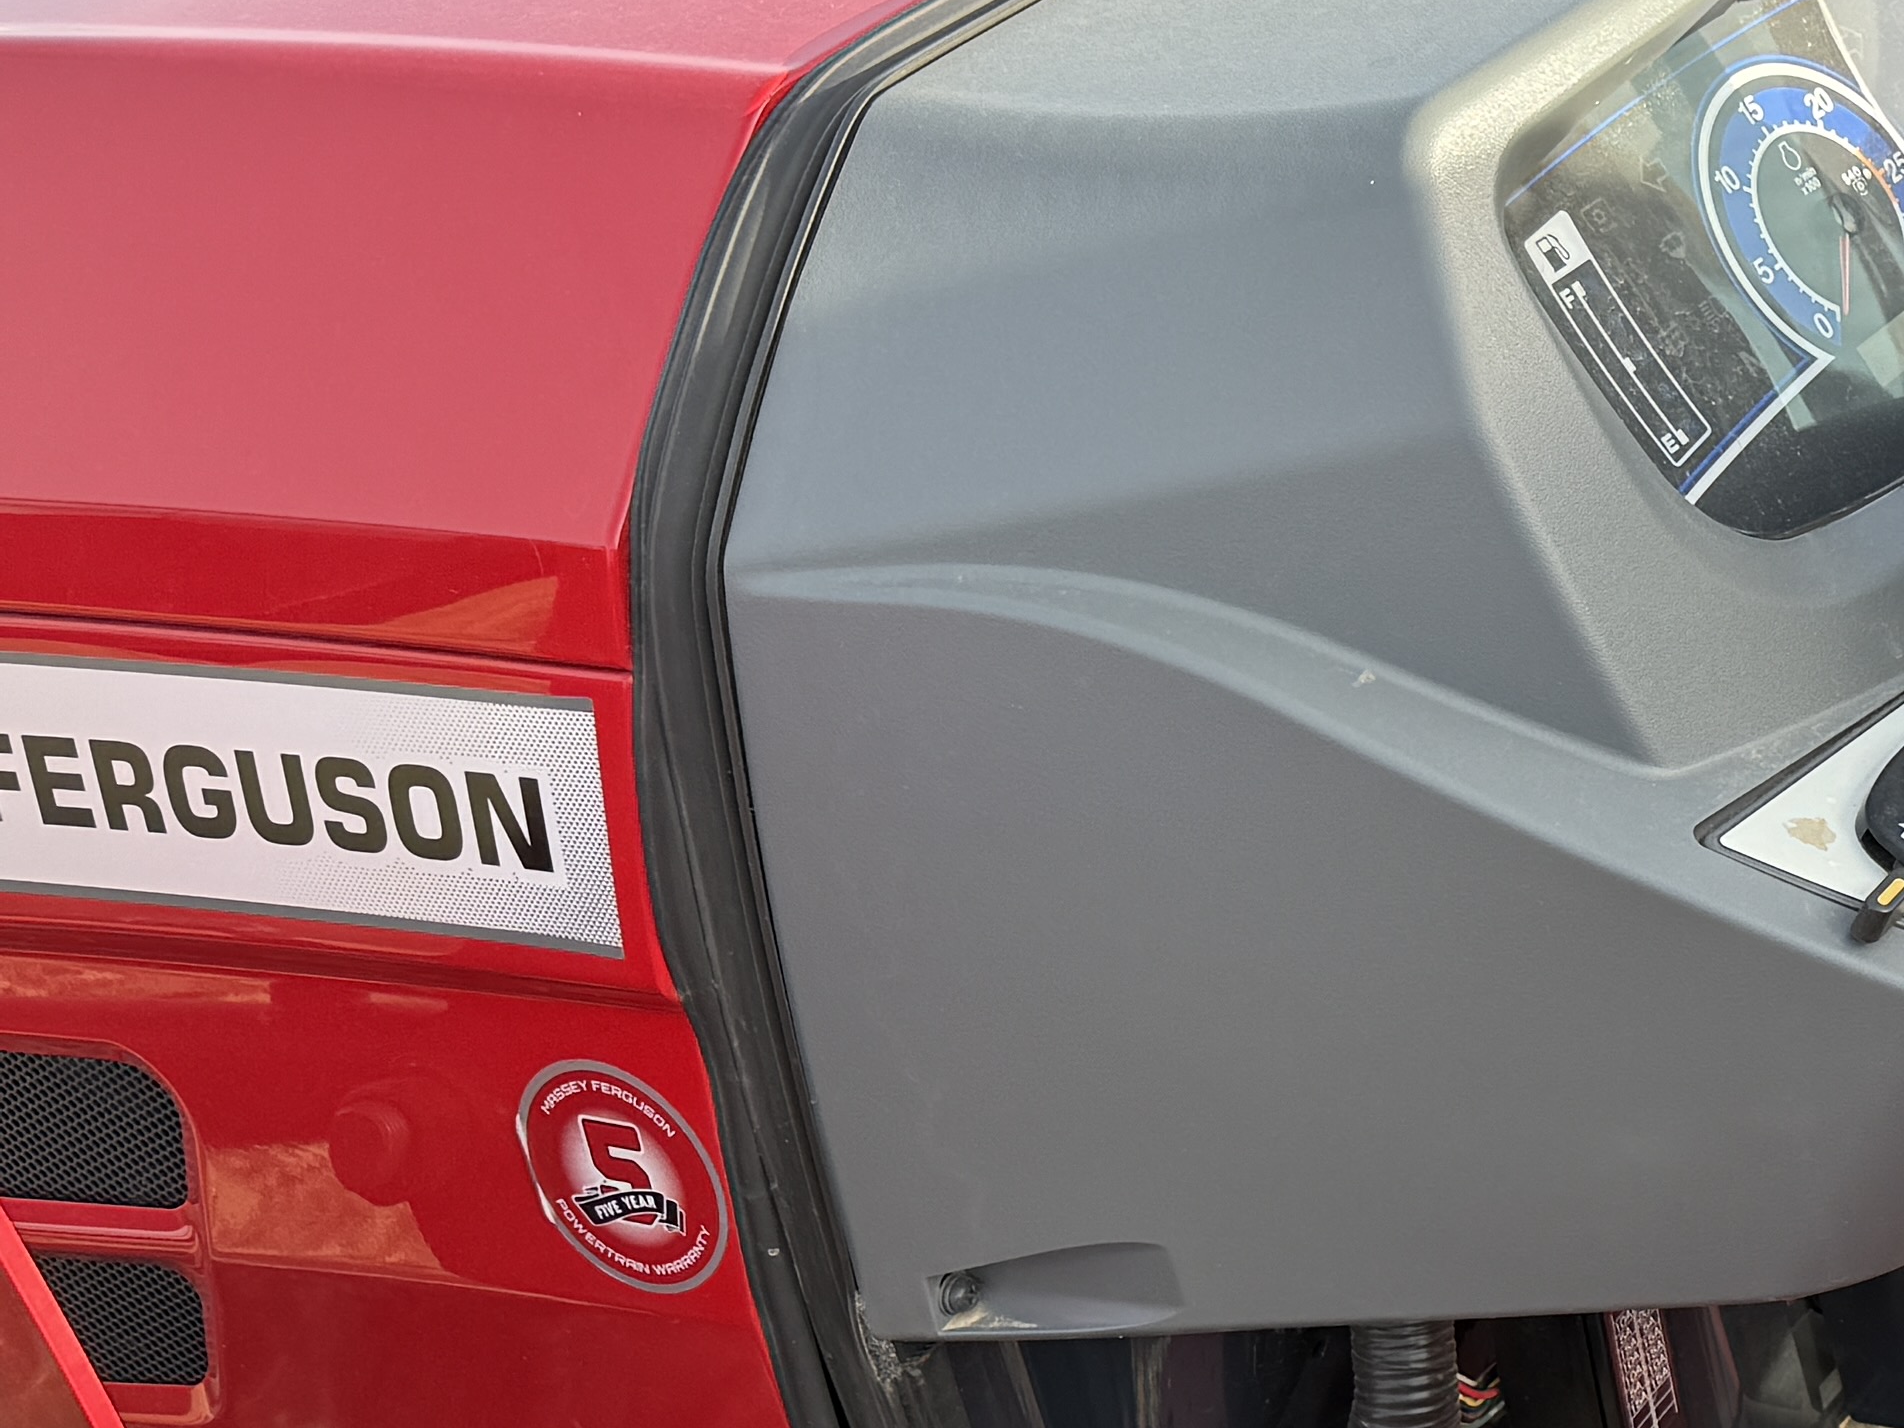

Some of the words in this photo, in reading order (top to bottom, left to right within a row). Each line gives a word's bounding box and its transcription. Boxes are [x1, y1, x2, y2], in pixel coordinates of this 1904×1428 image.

[1738, 94, 1764, 125] 15
[1803, 86, 1834, 121] 20
[1714, 165, 1741, 194] 10
[1753, 257, 1775, 285] 5
[1558, 287, 1575, 310] F
[1813, 312, 1834, 339] 0
[1660, 432, 1680, 454] E
[0, 733, 555, 873] ERGUSON
[541, 1079, 589, 1116] MASSEY
[590, 1079, 676, 1139] FERGUSON
[577, 1114, 654, 1226] 5
[594, 1199, 620, 1220] FIVE
[622, 1194, 657, 1211] YEAR
[555, 1198, 651, 1276] POWERTRAIN
[650, 1224, 712, 1276] WARRANTY
